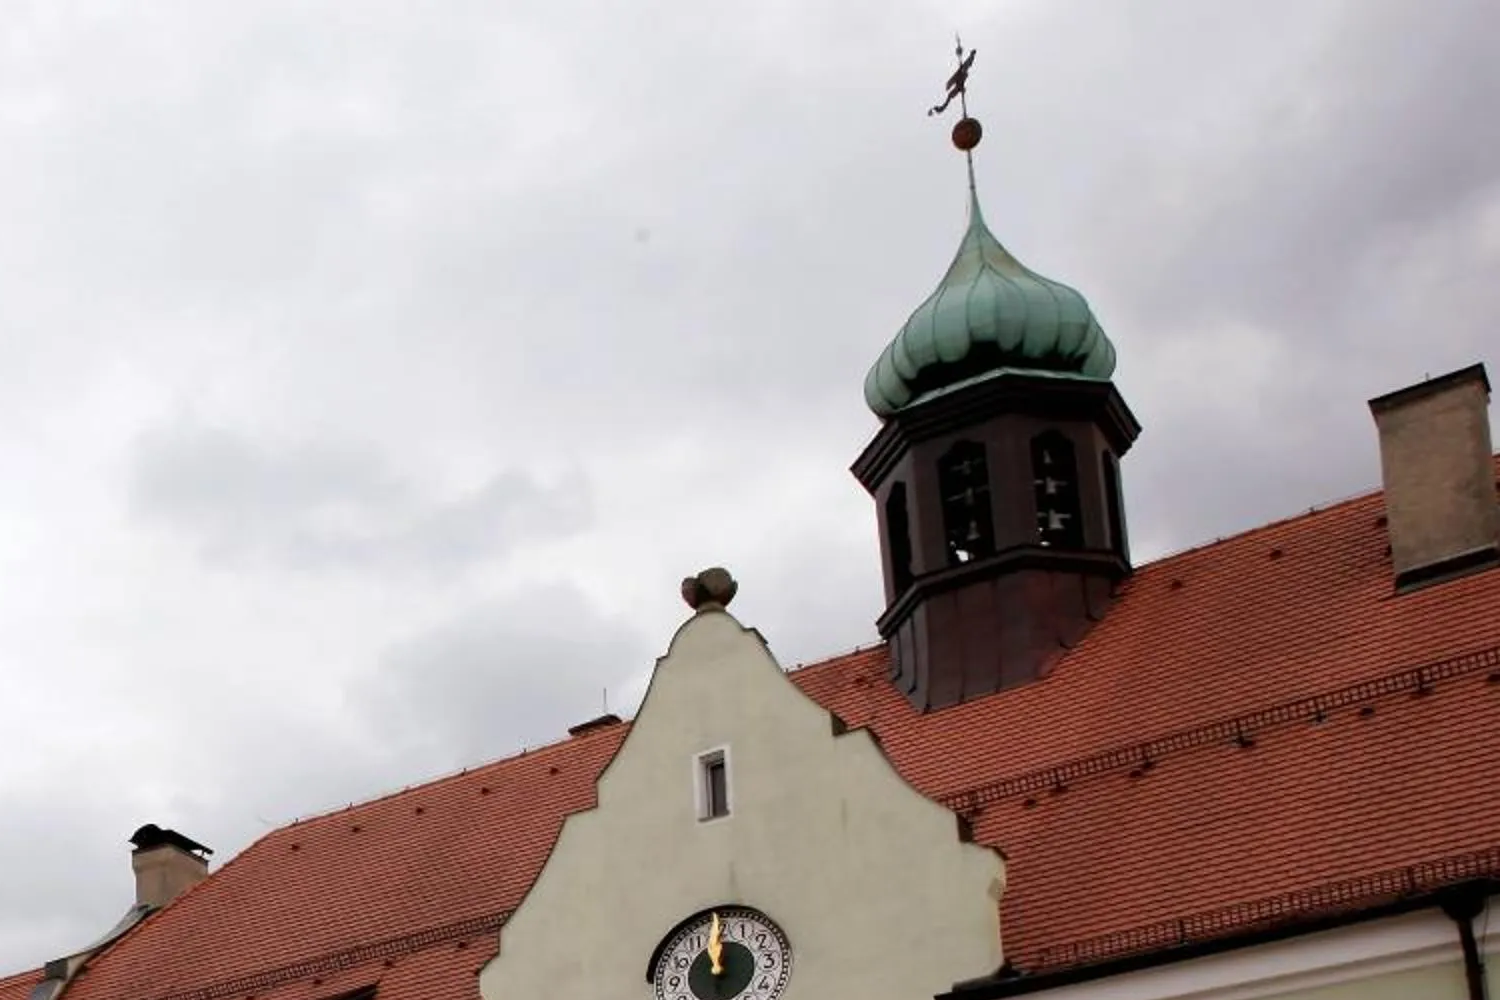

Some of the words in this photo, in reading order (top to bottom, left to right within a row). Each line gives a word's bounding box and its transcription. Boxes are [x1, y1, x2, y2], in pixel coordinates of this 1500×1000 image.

[688, 935, 702, 950] 11
[755, 933, 768, 949] 2
[674, 953, 689, 969] 10
[763, 954, 775, 969] 3
[669, 975, 681, 990] 9
[758, 975, 769, 991] 4
